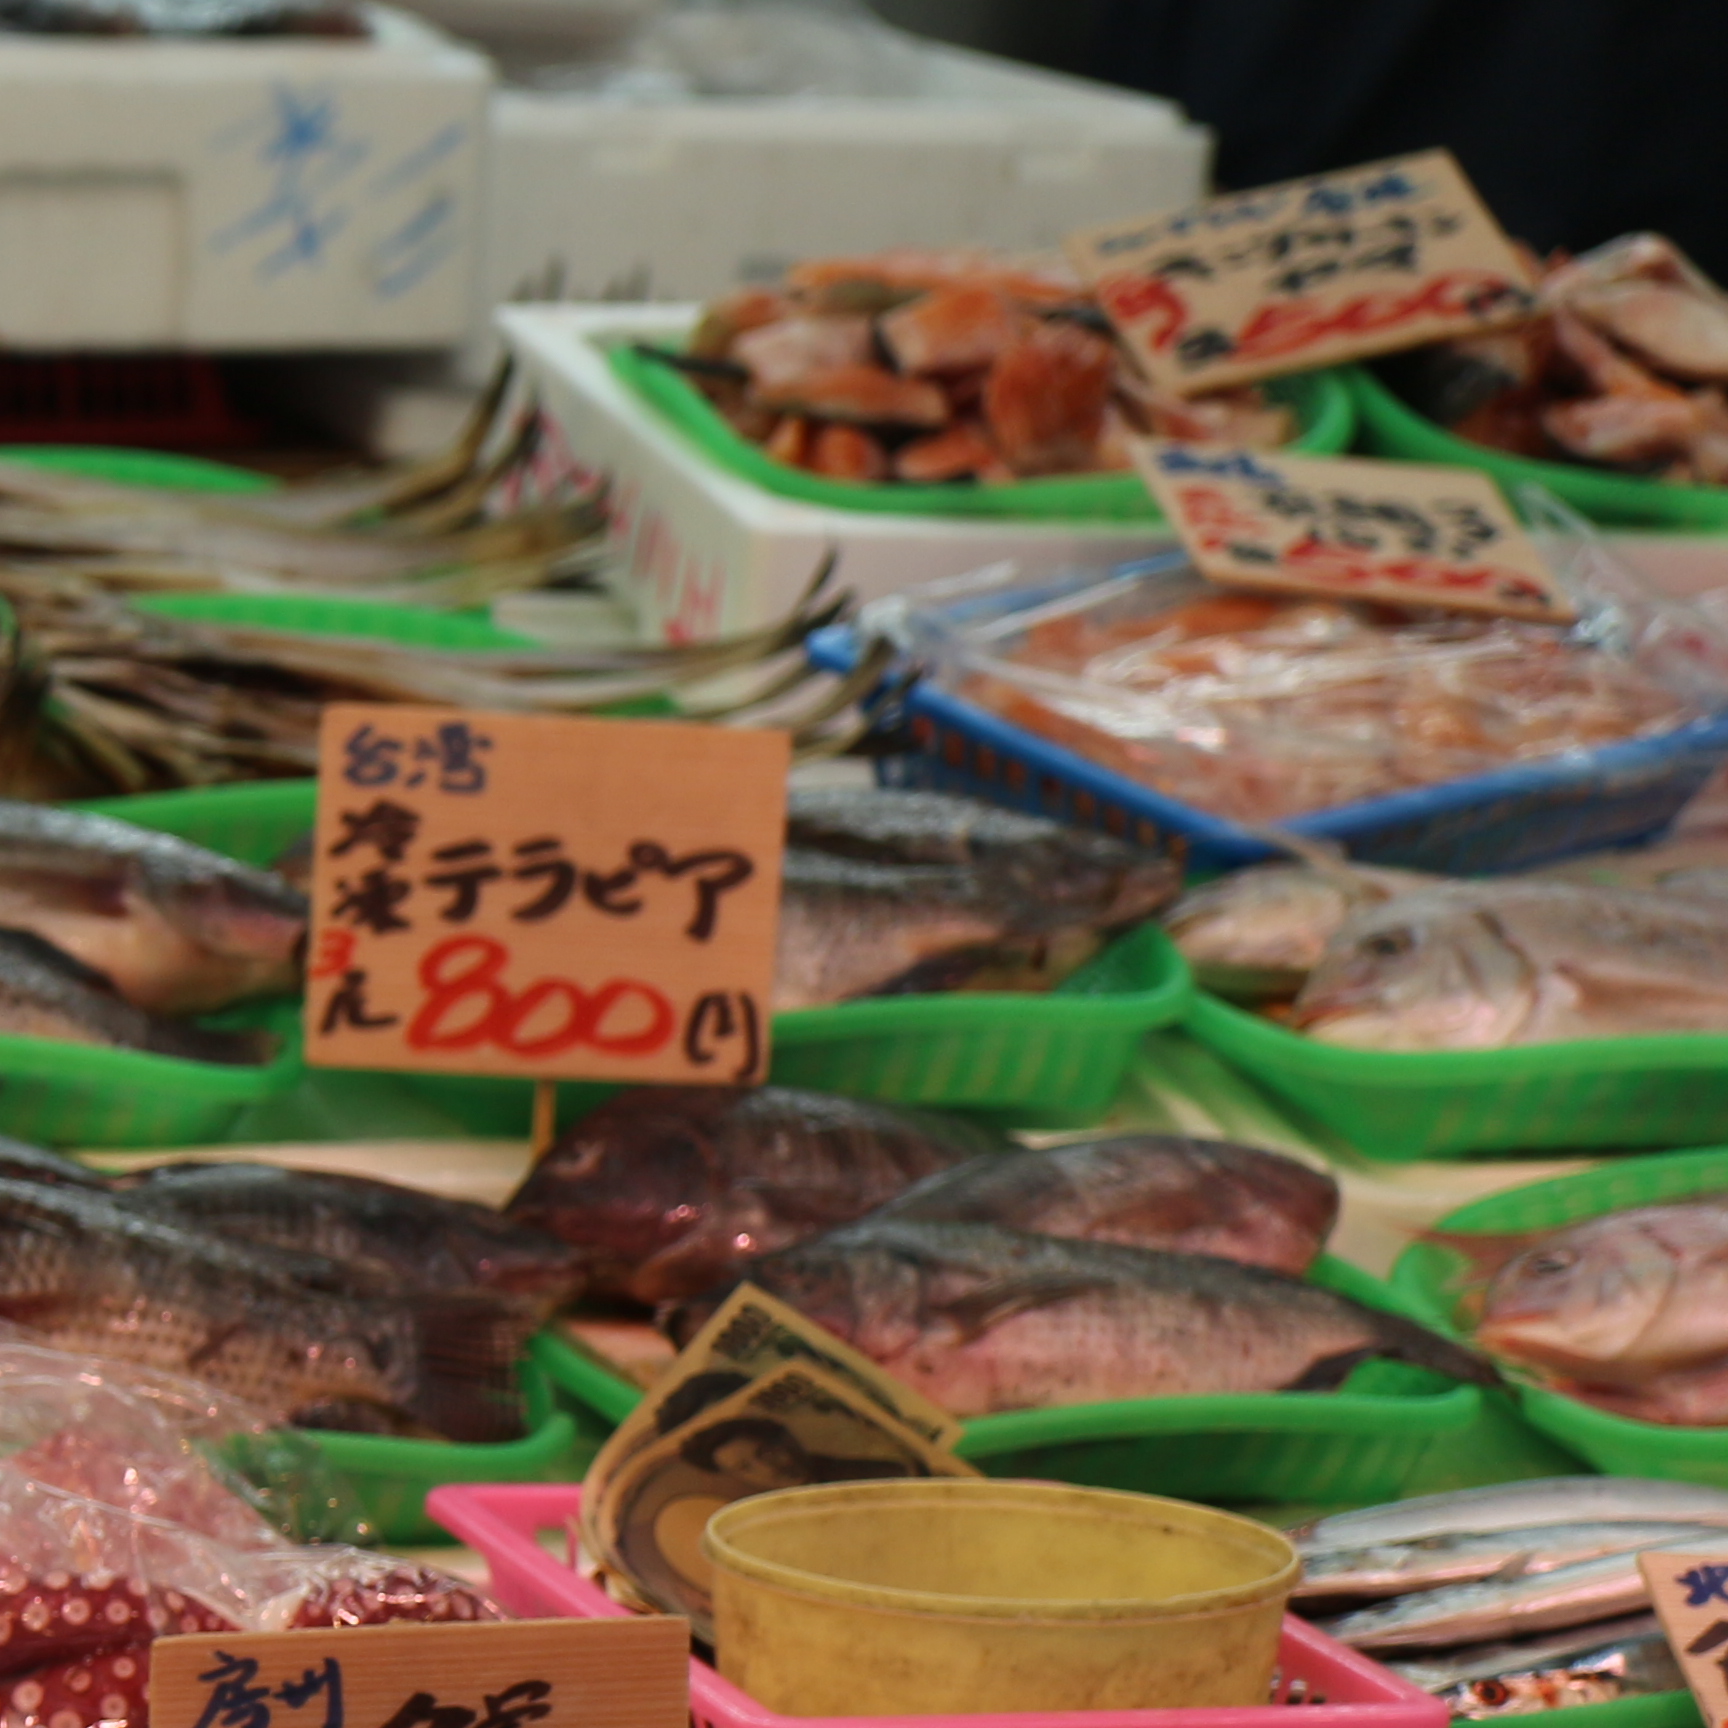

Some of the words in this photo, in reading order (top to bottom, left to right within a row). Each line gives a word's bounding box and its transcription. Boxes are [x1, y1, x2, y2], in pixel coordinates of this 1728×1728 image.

[343, 722, 494, 793] 台湾
[424, 835, 756, 945] テラピア
